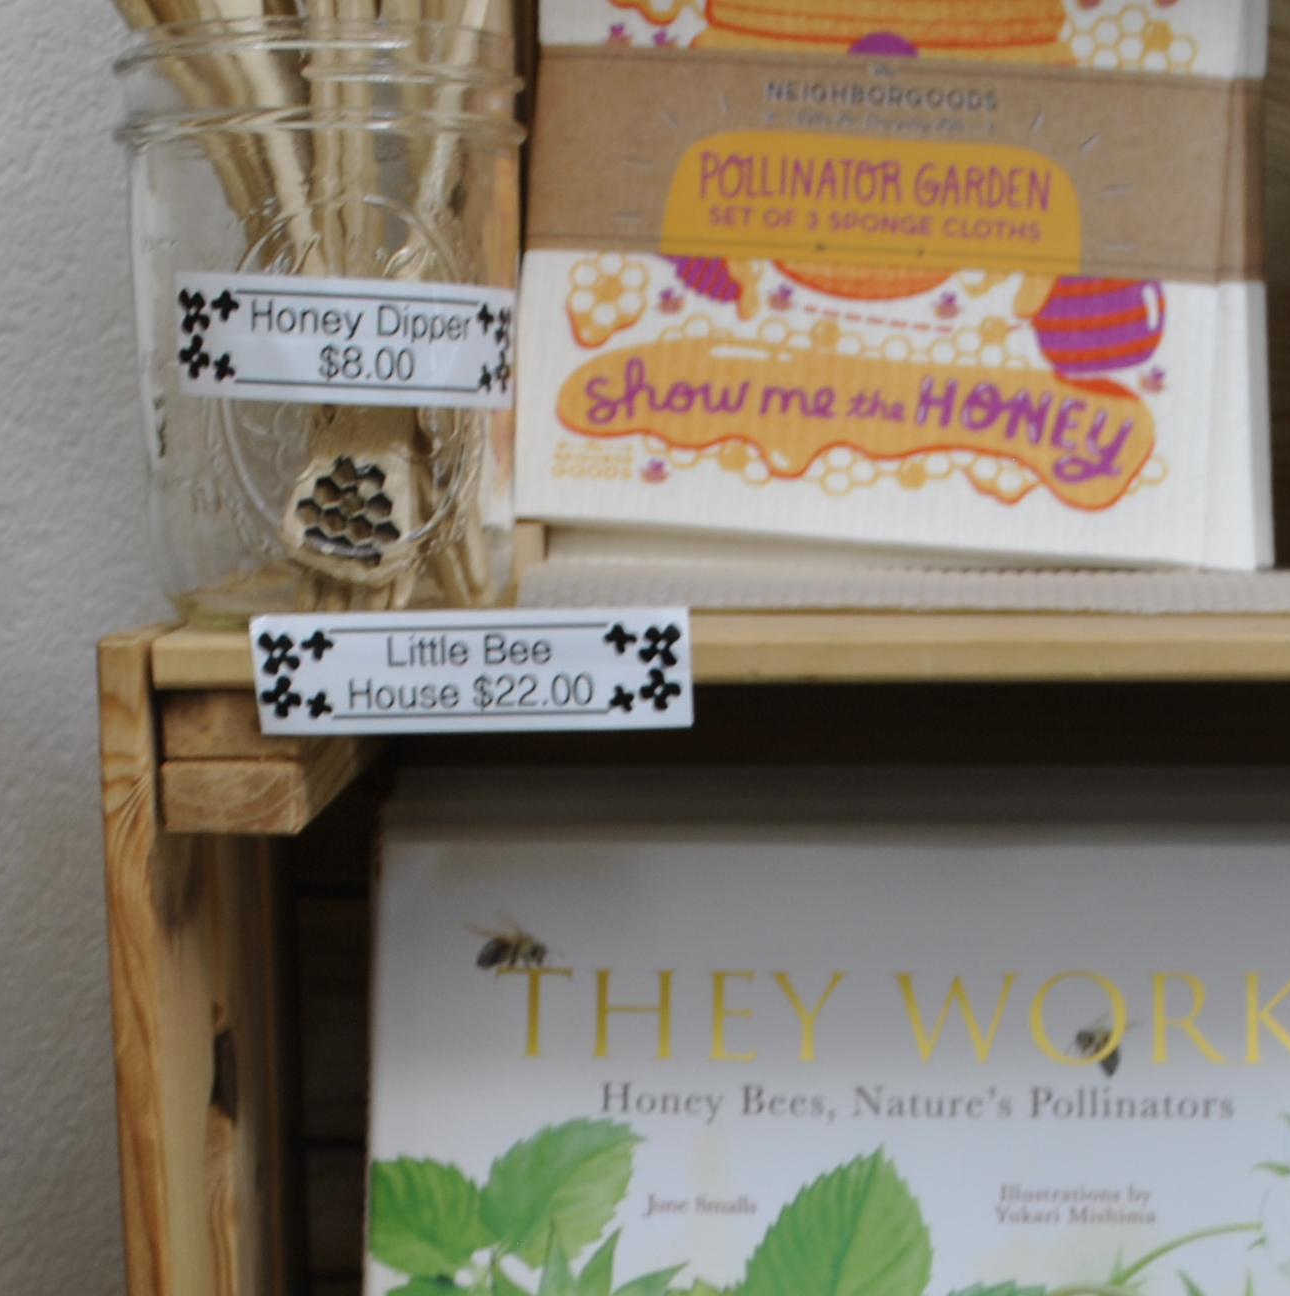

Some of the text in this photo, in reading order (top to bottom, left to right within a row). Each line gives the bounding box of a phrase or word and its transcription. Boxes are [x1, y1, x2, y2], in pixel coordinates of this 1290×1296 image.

[765, 81, 998, 112] NEIGHBORGOODS
[700, 152, 1052, 211] POLLINATOR GARDEN
[709, 207, 1042, 243] SET OF 3 SPONGE CLOTHS
[250, 297, 471, 344] Honey Dipper
[319, 343, 415, 383] $8.00
[585, 358, 1133, 484] show me the HONEY
[386, 635, 552, 669] Little Bee
[348, 673, 594, 713] House $22.00
[493, 966, 847, 1059] THEY
[600, 1081, 1237, 1125] Honey Bees, Nature's Pollinators
